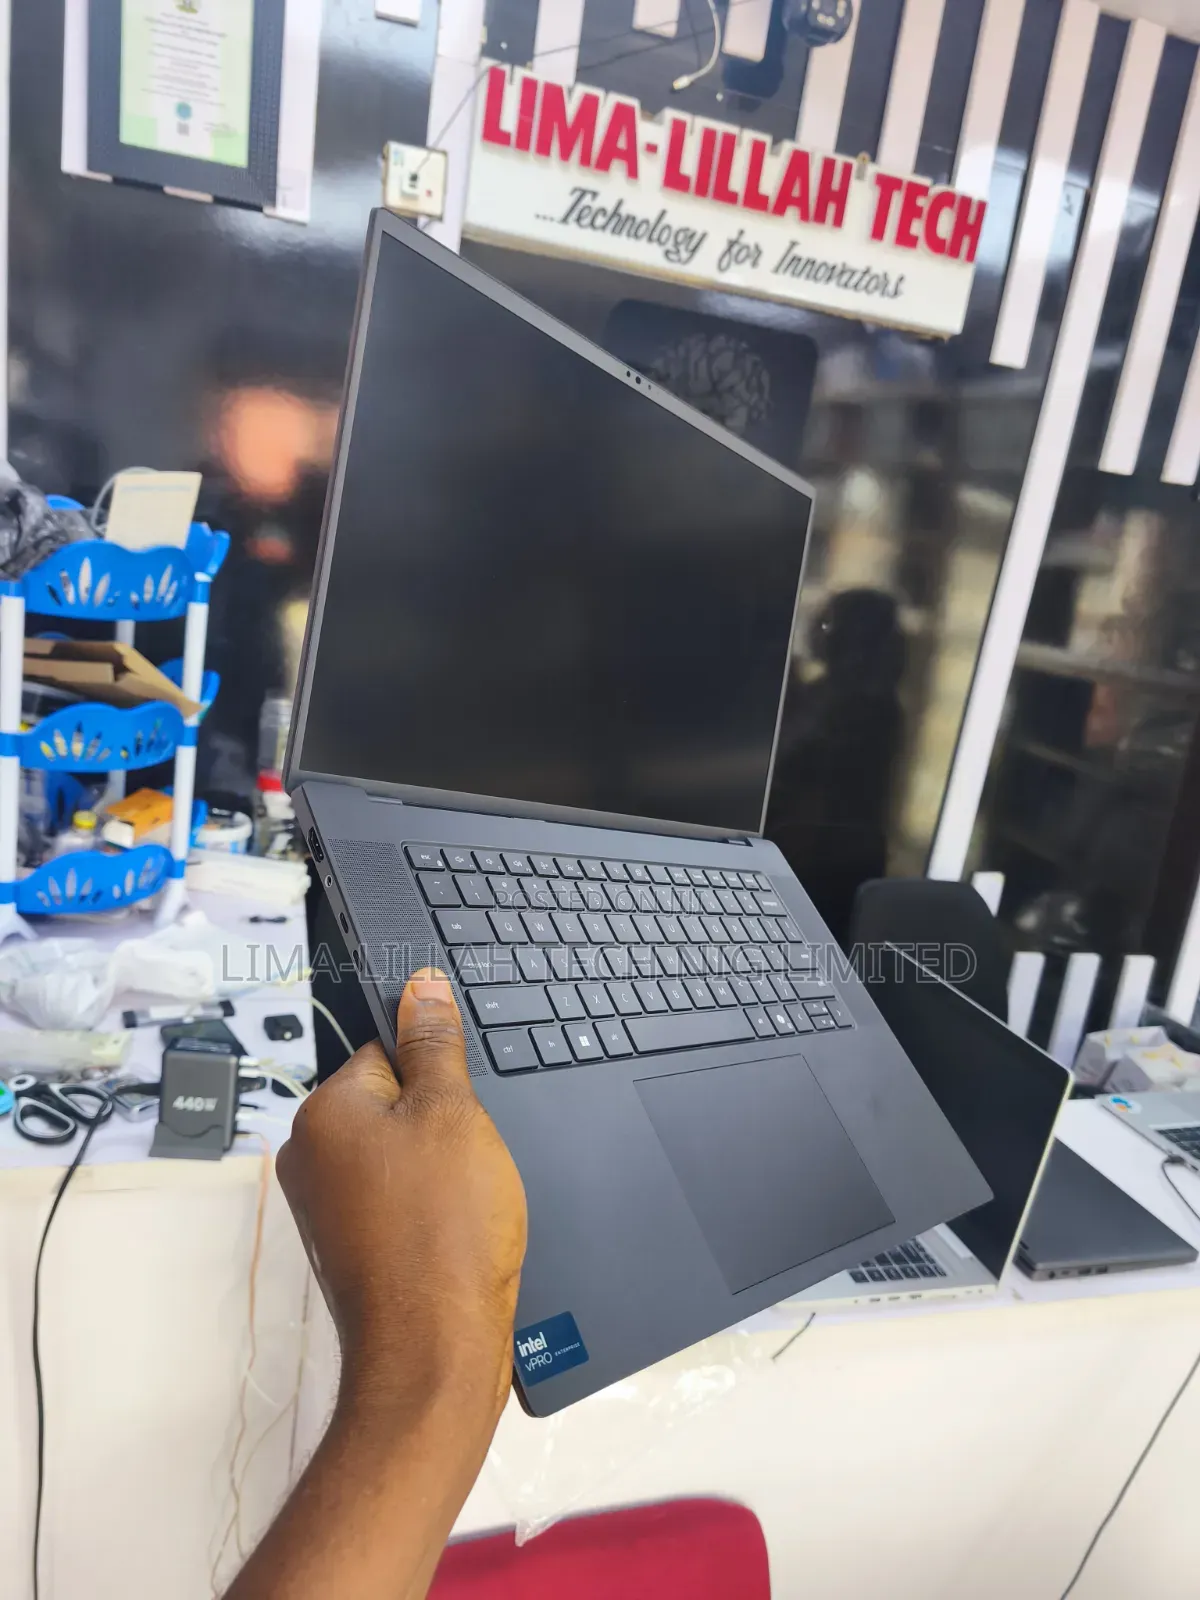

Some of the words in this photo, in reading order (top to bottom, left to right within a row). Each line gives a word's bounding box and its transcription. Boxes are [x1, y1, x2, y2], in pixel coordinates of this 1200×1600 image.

[482, 65, 853, 229] LIMA-LILLAH
[869, 173, 987, 263] TECH
[718, 229, 763, 273] for
[772, 240, 906, 299] Innovators
[485, 1001, 500, 1009] shift
[503, 1045, 514, 1053] ctrl
[516, 1331, 548, 1358] intel
[524, 1352, 553, 1372] vPRO
